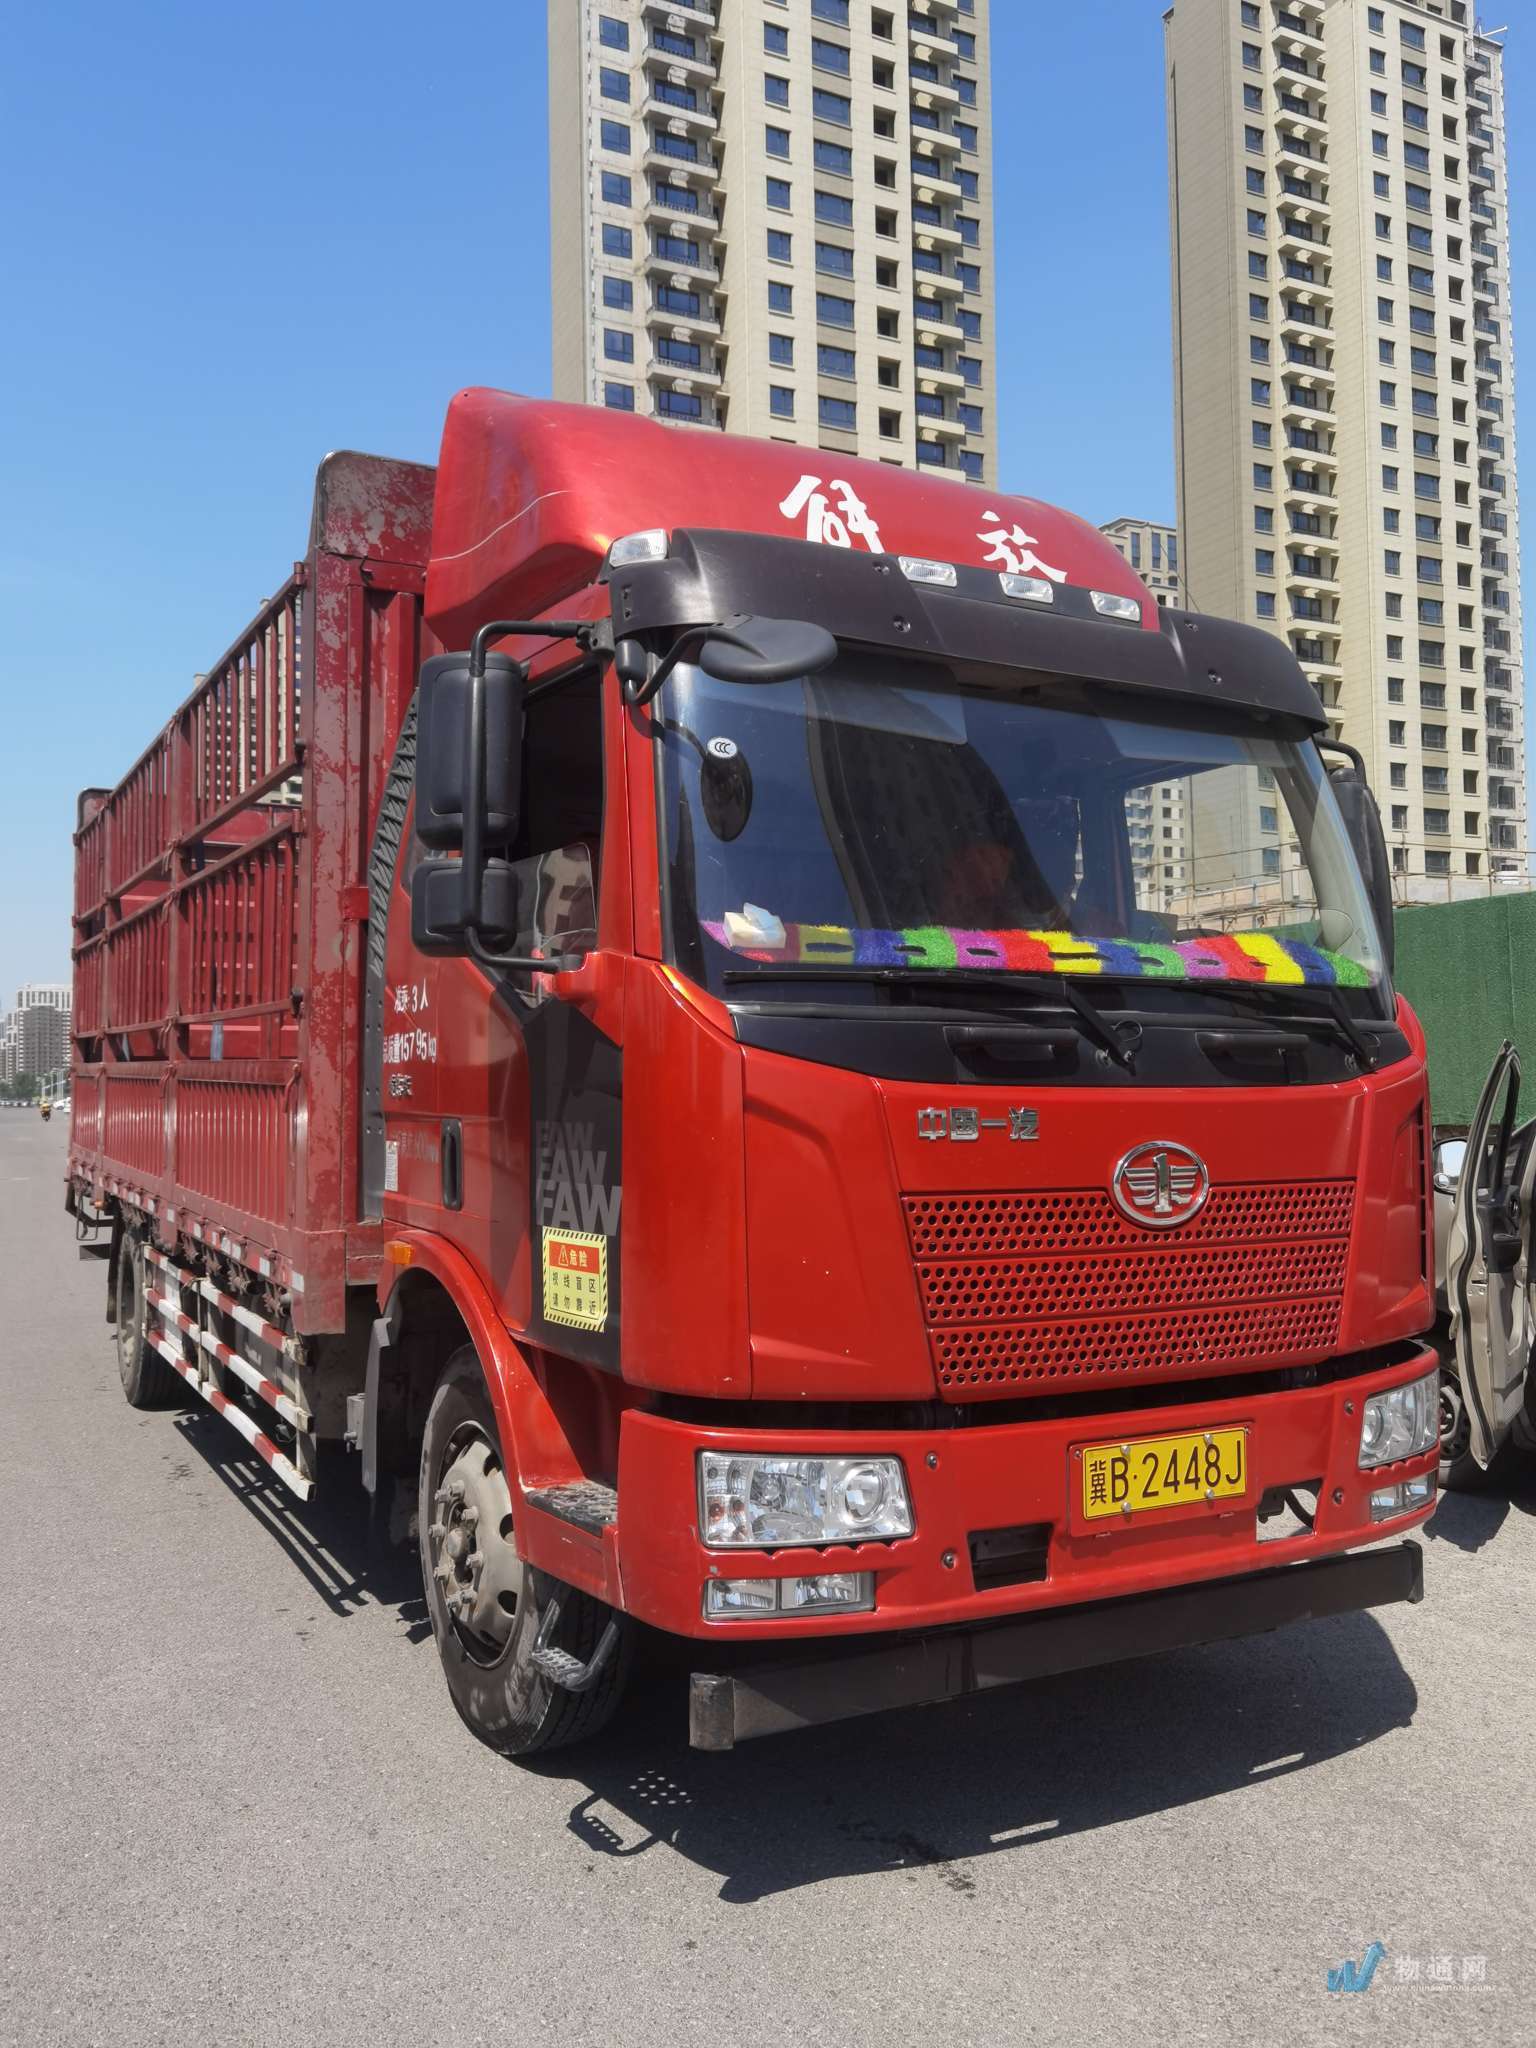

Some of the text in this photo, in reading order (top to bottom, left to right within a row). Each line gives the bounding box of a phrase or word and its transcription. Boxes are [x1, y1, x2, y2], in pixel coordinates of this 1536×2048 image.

[917, 1106, 1040, 1141] 中国一汽
[536, 1150, 608, 1184] FAW
[536, 1179, 623, 1236] FAW
